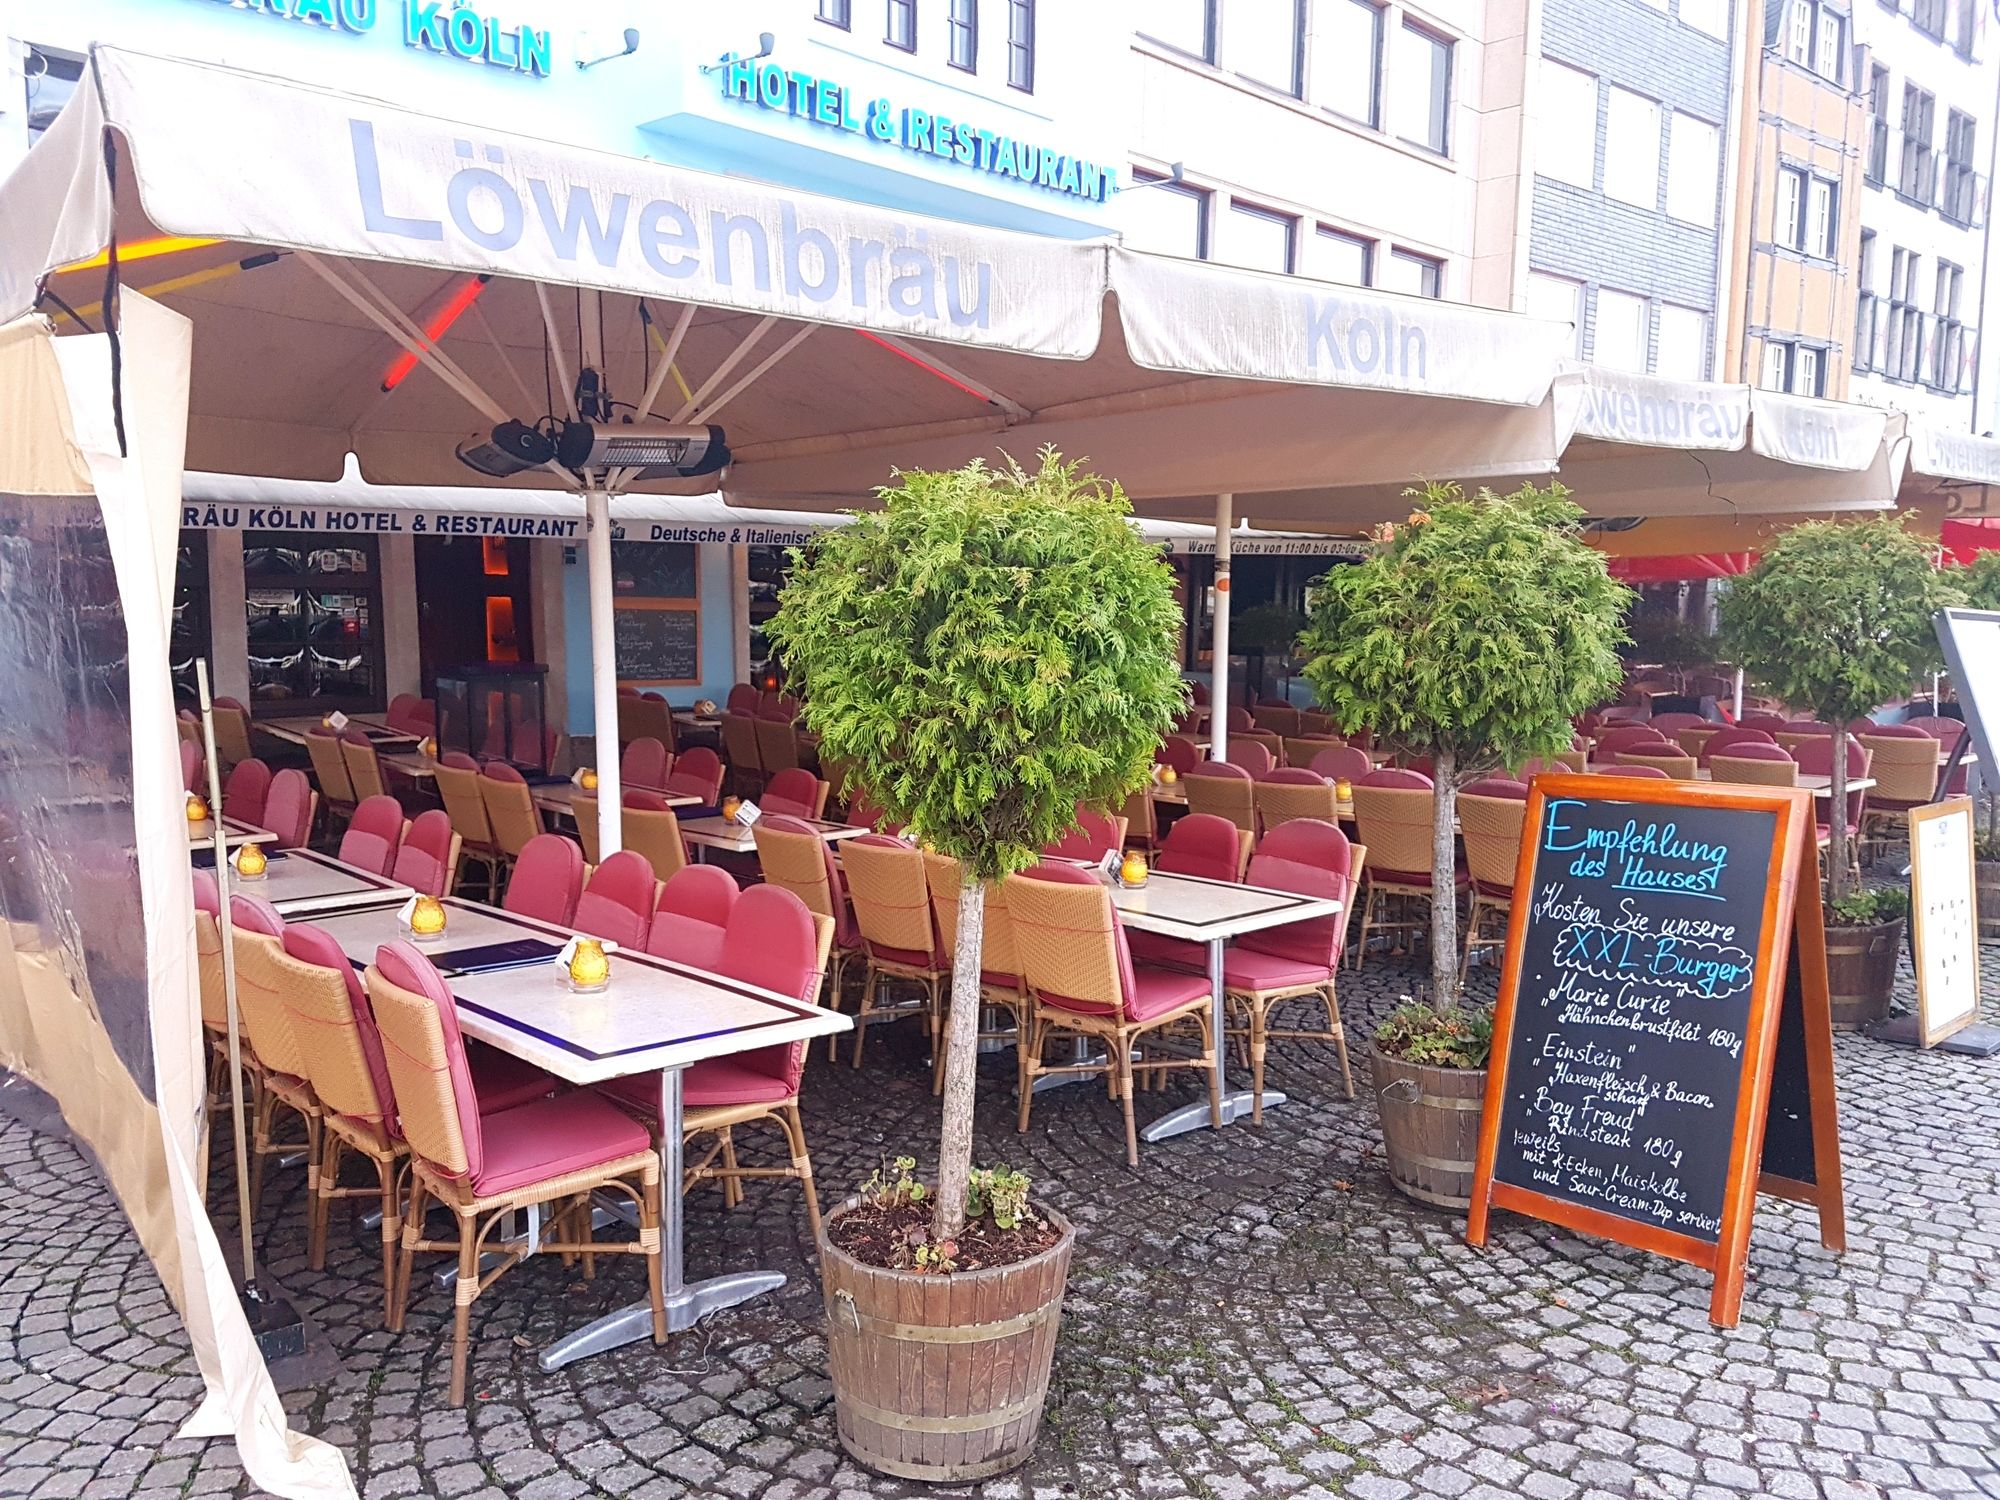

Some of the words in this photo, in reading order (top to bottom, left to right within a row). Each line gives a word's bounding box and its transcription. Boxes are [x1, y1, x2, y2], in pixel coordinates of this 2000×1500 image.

[403, 0, 551, 78] KÖLN
[723, 51, 860, 131] HOTEL
[866, 97, 896, 142] &
[902, 107, 1118, 202] RESTAURANT
[348, 117, 991, 331] Löwenbräu
[1304, 292, 1427, 380] Köln
[248, 505, 316, 528] KÖLN
[326, 511, 402, 531] HOTEL
[412, 514, 427, 531] &
[435, 515, 578, 537] RESTAURANT
[650, 524, 726, 543] Deutsche
[730, 527, 741, 543] &
[746, 528, 818, 545] Italienisc
[1188, 540, 1216, 553] Warm
[1230, 540, 1261, 553] Küche
[1264, 544, 1282, 553] von
[1285, 543, 1311, 554] 11:00
[1313, 543, 1329, 554] bis
[1544, 800, 1728, 885] Empfehlung
[1569, 852, 1606, 878] des
[1620, 855, 1707, 891] Hauses
[1533, 882, 1602, 924] Kosten
[1613, 897, 1650, 931] Sie
[1661, 917, 1736, 942] unsere
[1558, 1003, 1701, 1043] Hähnchenbrustfilet
[1650, 1081, 1661, 1099] &
[1548, 1115, 1631, 1148] Rindsteak
[1522, 1149, 1547, 1165] mit
[1533, 1169, 1560, 1186] und
